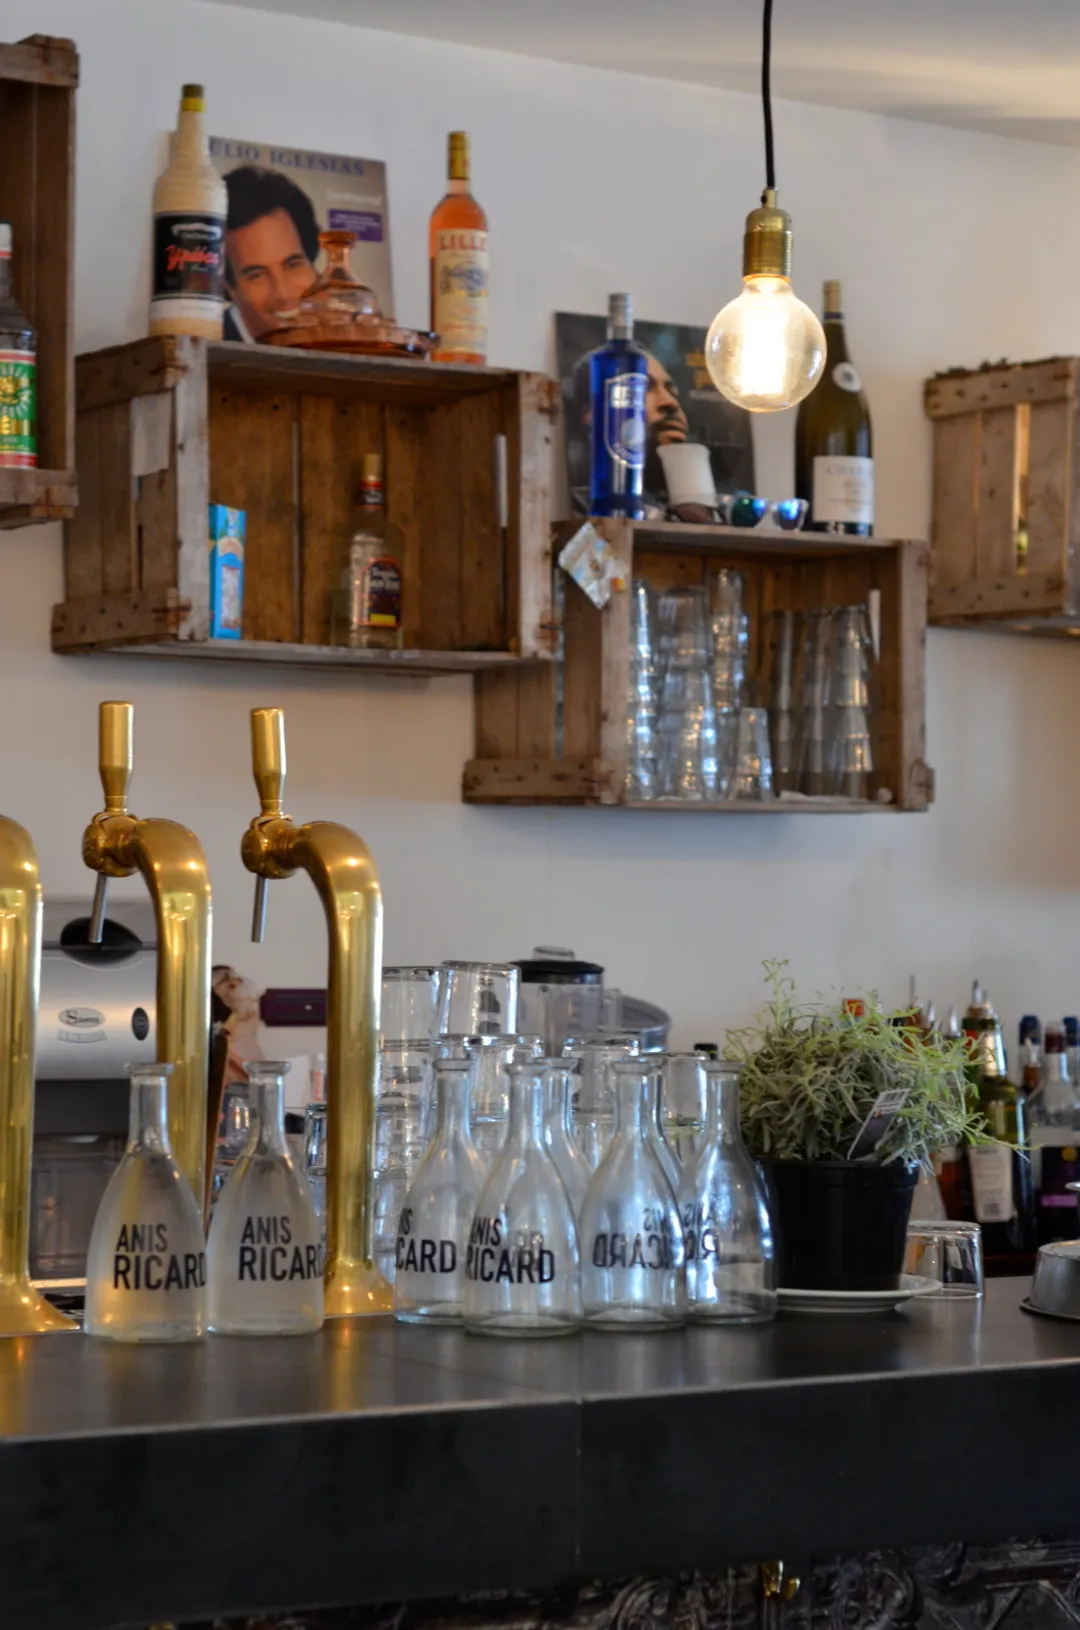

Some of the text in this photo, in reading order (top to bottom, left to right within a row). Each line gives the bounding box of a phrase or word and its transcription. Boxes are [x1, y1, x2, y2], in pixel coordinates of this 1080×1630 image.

[269, 151, 365, 177] IGLESIAS
[115, 1224, 168, 1253] ANIS
[239, 1216, 292, 1245] ANIS
[465, 1245, 555, 1285] RICARD
